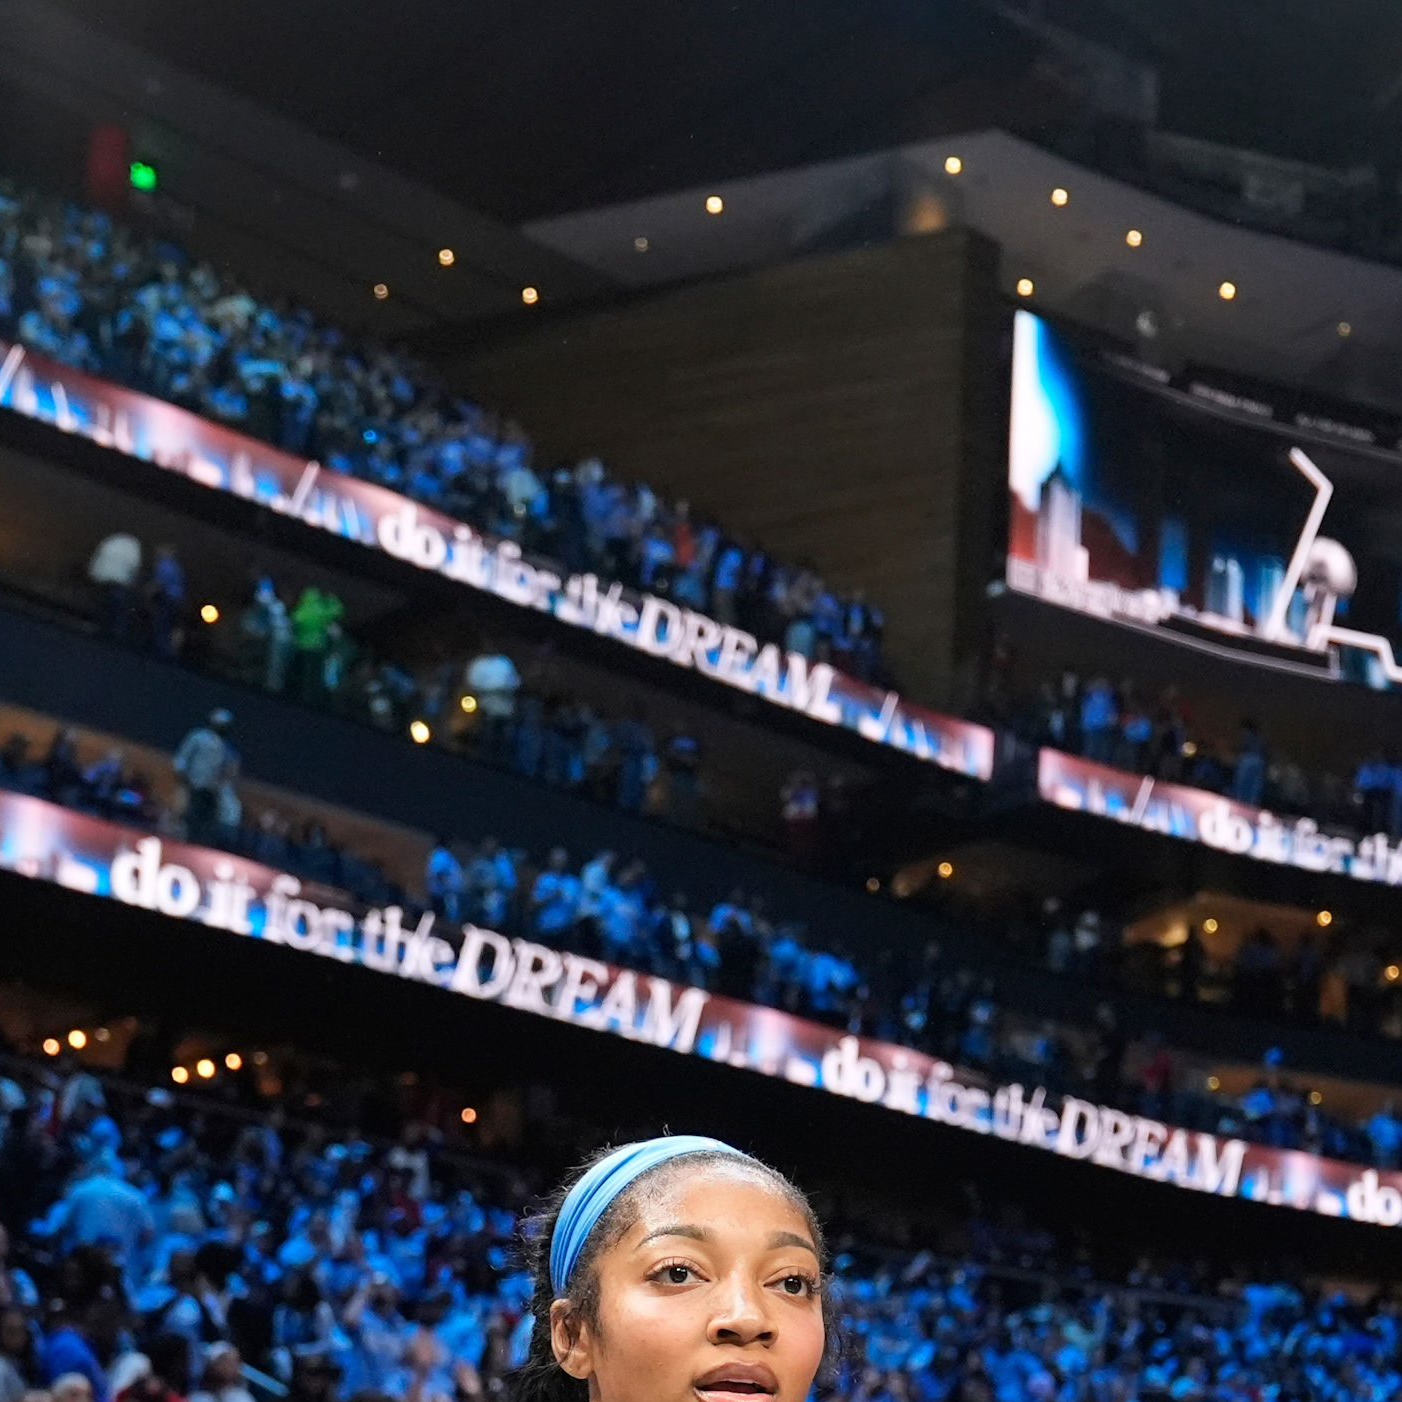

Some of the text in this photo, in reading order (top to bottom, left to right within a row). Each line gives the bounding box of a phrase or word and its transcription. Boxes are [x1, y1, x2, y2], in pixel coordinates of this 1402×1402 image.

[378, 501, 446, 569] do
[495, 540, 562, 611] for
[555, 572, 639, 639] the
[636, 594, 842, 725] DREAM
[1198, 800, 1254, 854] do
[110, 836, 711, 1054] do it for the DREAM
[822, 1035, 886, 1103] do
[926, 1061, 992, 1134] for
[993, 1083, 1061, 1149] the
[1055, 1095, 1249, 1198] DREAM
